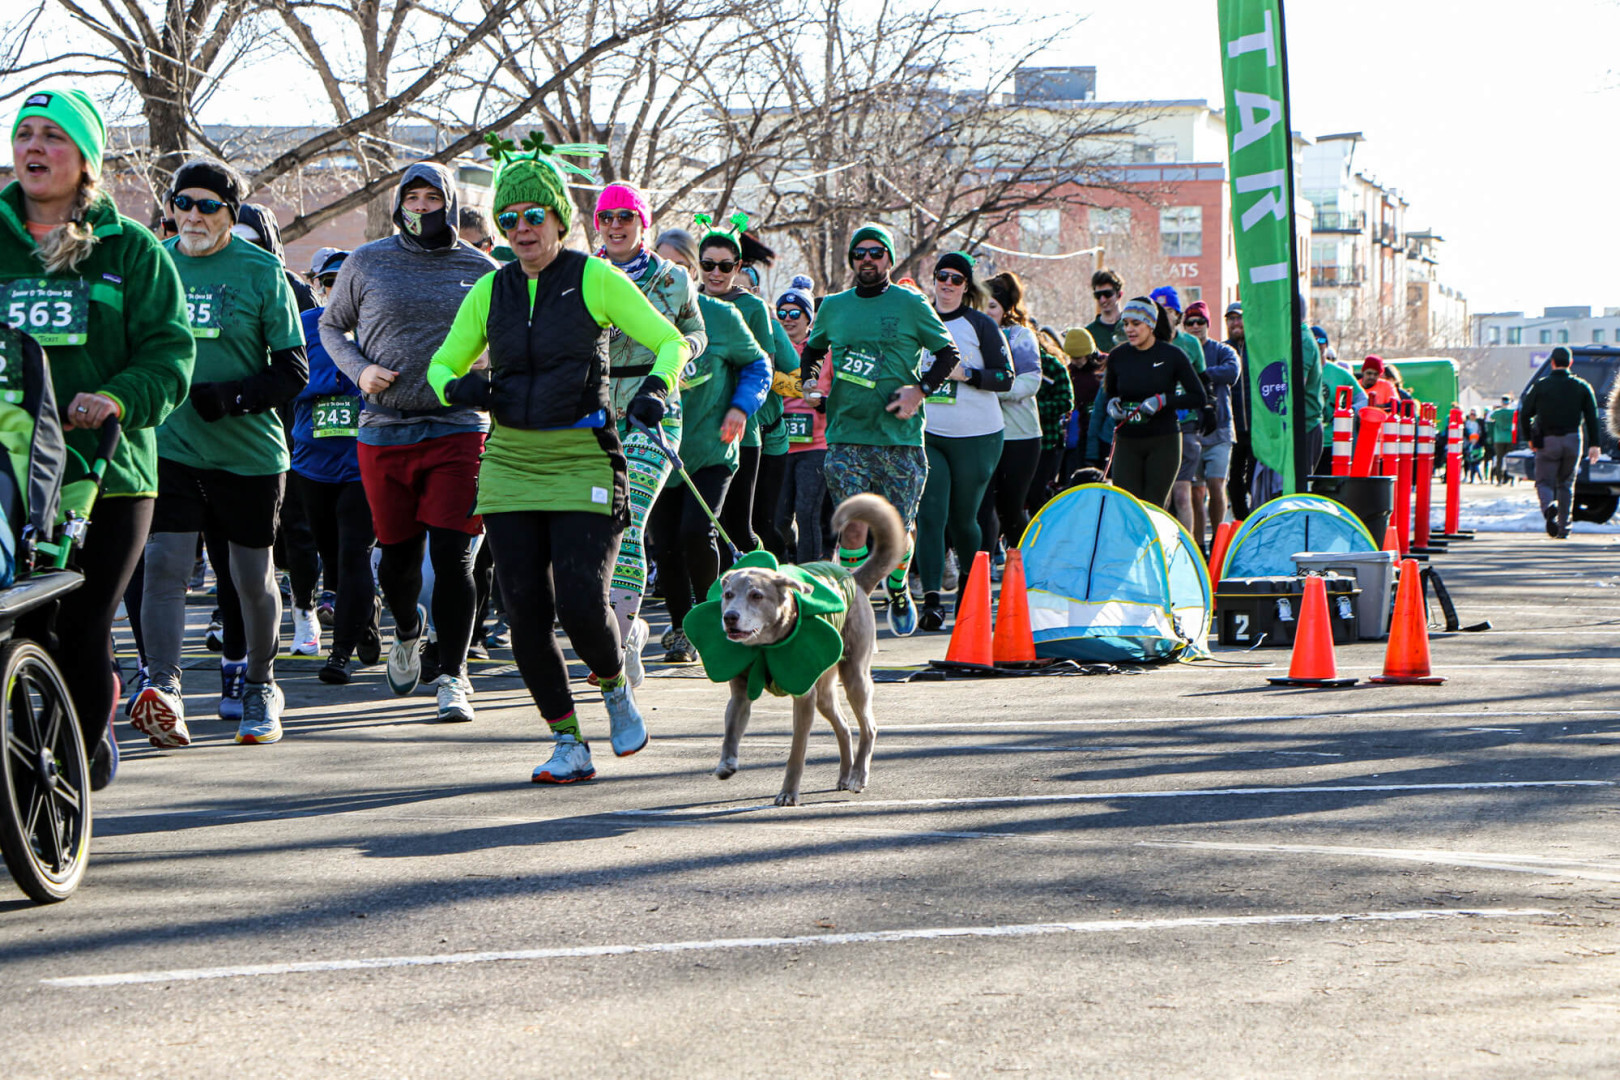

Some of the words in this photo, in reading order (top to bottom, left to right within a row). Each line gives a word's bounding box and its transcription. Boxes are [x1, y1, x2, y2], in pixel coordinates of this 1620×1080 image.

[8, 301, 72, 328] 563
[842, 356, 875, 376] 297
[317, 409, 351, 426] 243
[1235, 614, 1250, 641] 2
